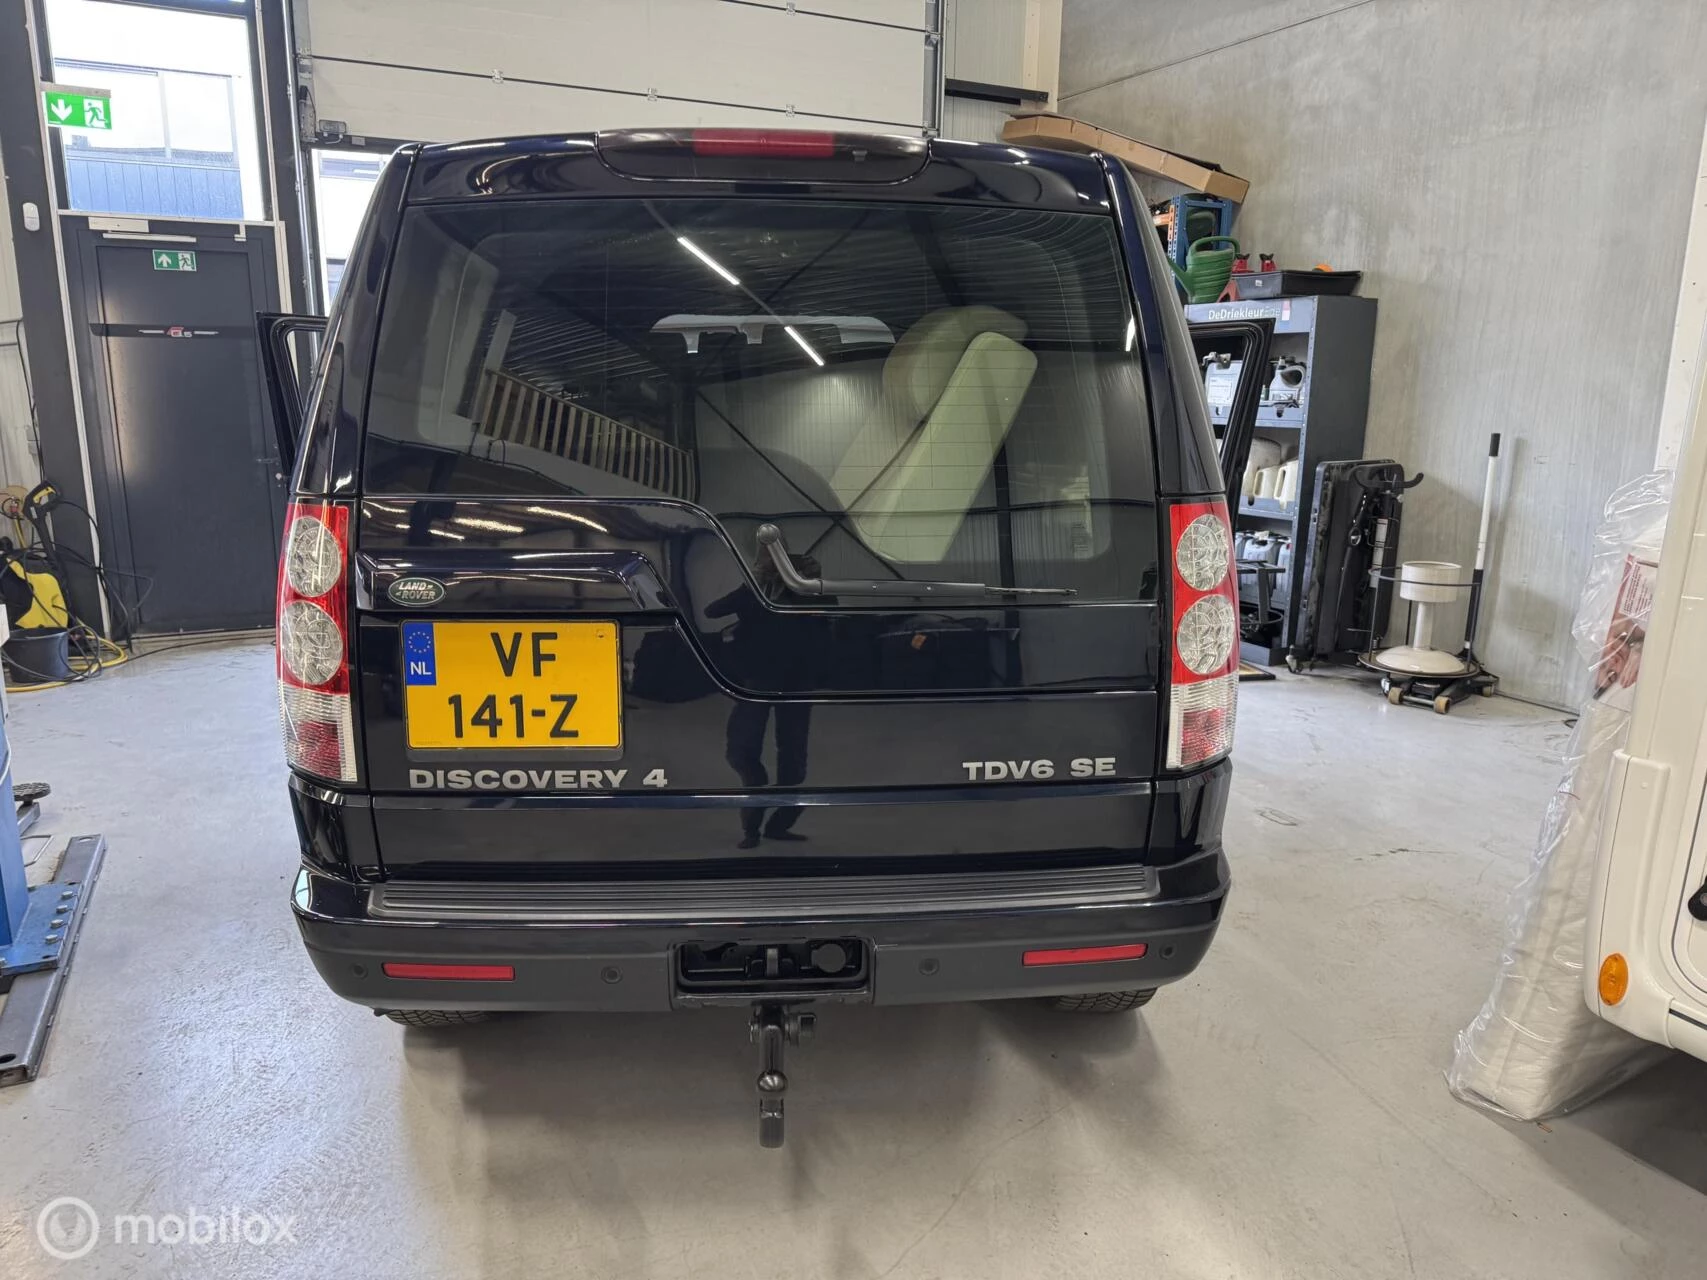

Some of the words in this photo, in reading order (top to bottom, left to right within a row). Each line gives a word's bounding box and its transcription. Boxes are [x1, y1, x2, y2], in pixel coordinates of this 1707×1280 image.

[399, 582, 427, 591] LAND
[401, 590, 436, 600] ROVER
[490, 632, 558, 677] VF
[410, 661, 432, 676] NL
[448, 694, 579, 738] 141-Z
[409, 768, 628, 789] DISCOVERY
[642, 768, 668, 788] 4
[962, 759, 1055, 781] TDV6
[1070, 757, 1116, 777] SE
